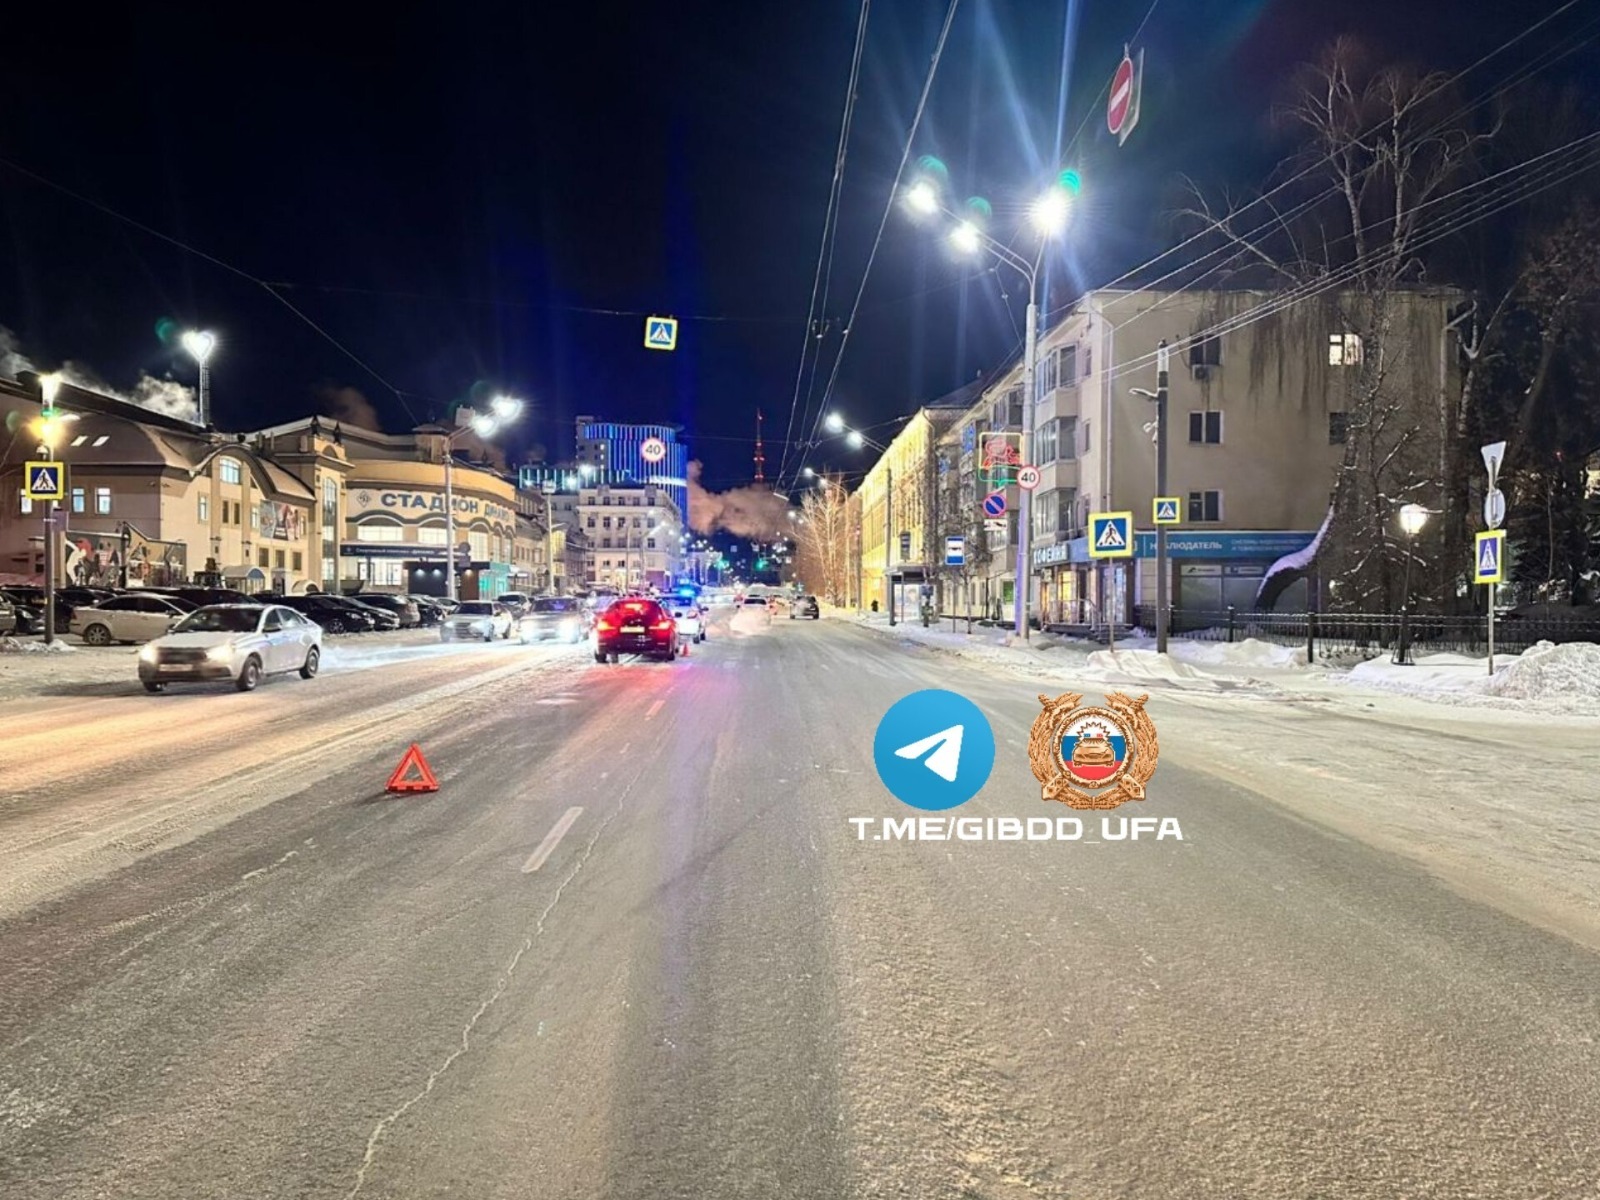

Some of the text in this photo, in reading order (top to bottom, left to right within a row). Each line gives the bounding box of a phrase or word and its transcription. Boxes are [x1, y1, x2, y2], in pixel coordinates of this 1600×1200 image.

[645, 444, 661, 456] 40
[1020, 472, 1036, 483] 40
[381, 493, 479, 514] СТАДИОН
[1150, 541, 1223, 551] НЛЮДАТЕЛЬ
